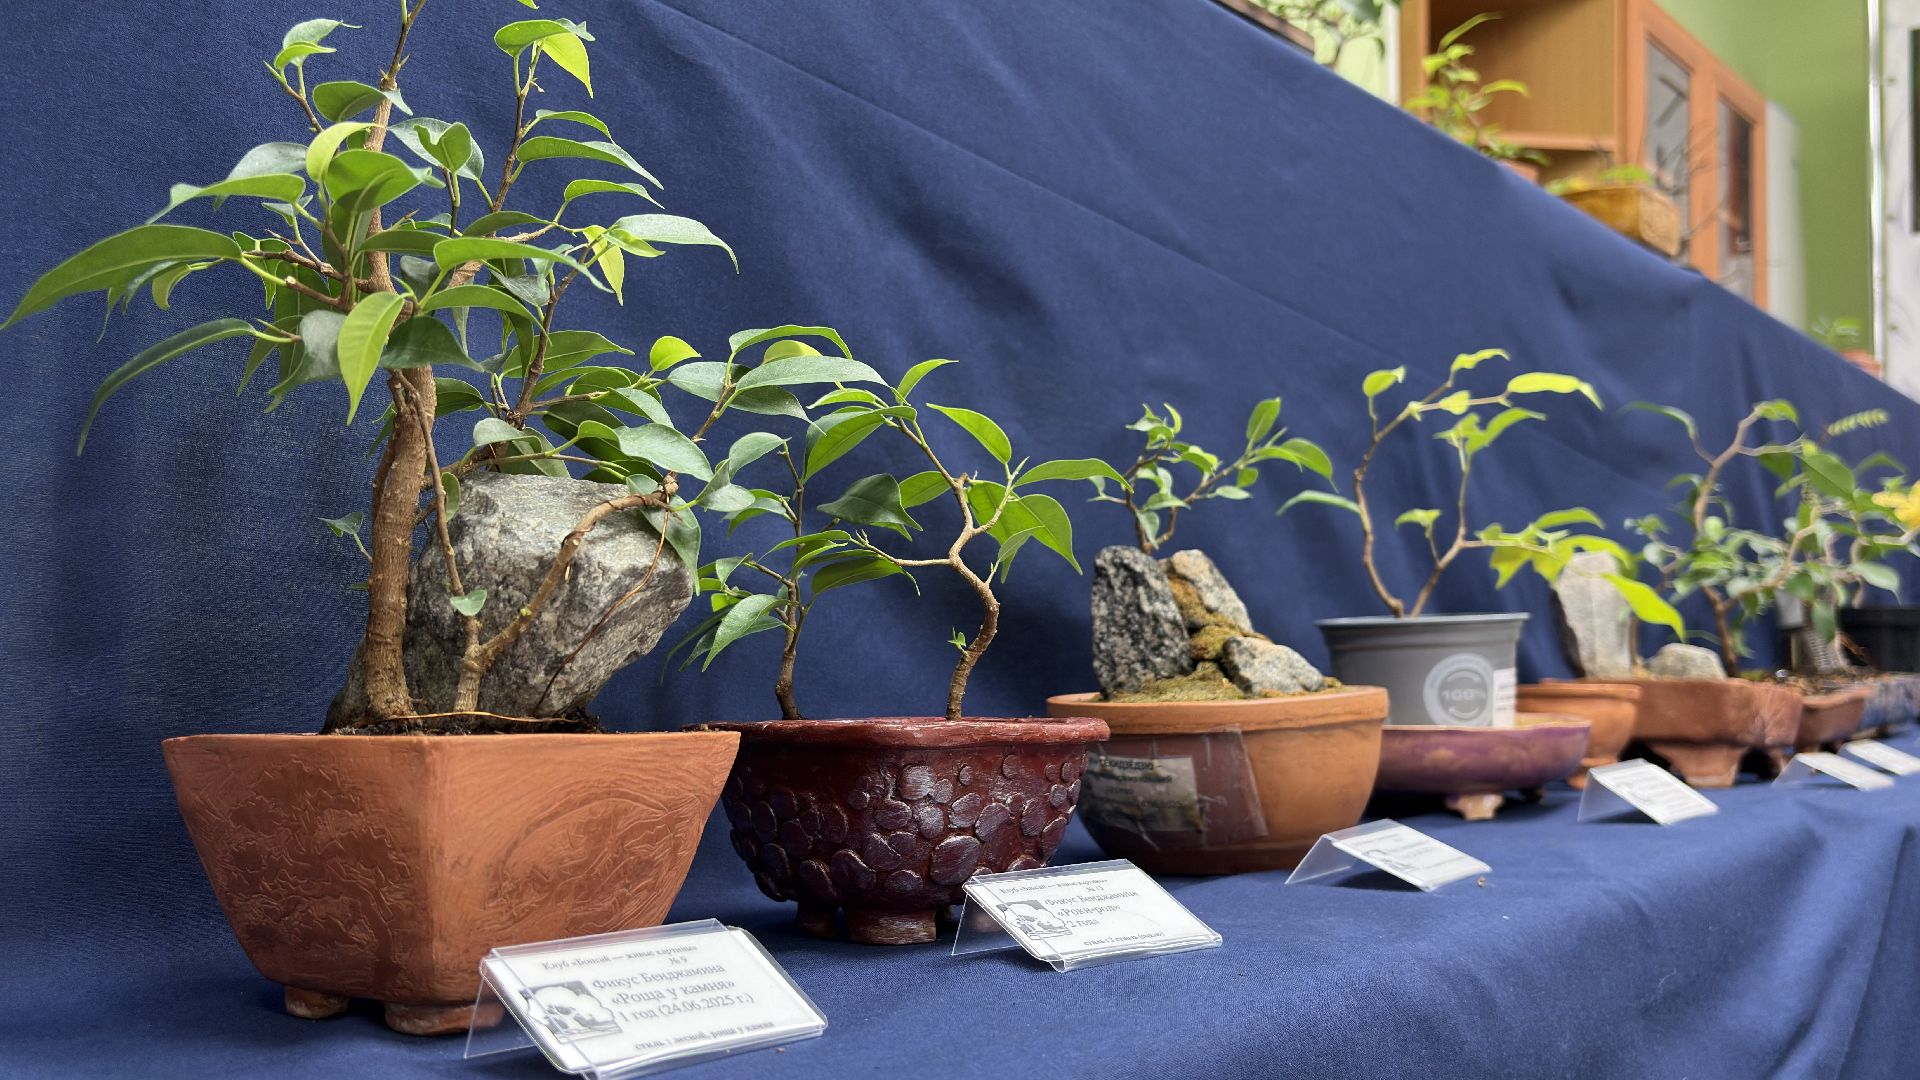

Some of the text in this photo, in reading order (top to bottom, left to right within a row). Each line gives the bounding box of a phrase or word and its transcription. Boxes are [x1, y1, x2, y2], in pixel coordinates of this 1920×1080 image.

[1066, 920, 1077, 928] 2
[541, 960, 570, 970] Клуб
[592, 964, 726, 989] Фикус Бенджамина
[611, 980, 735, 1004] «Роща у камня»
[619, 992, 755, 1021] 1 год (24.06.2025 г.)
